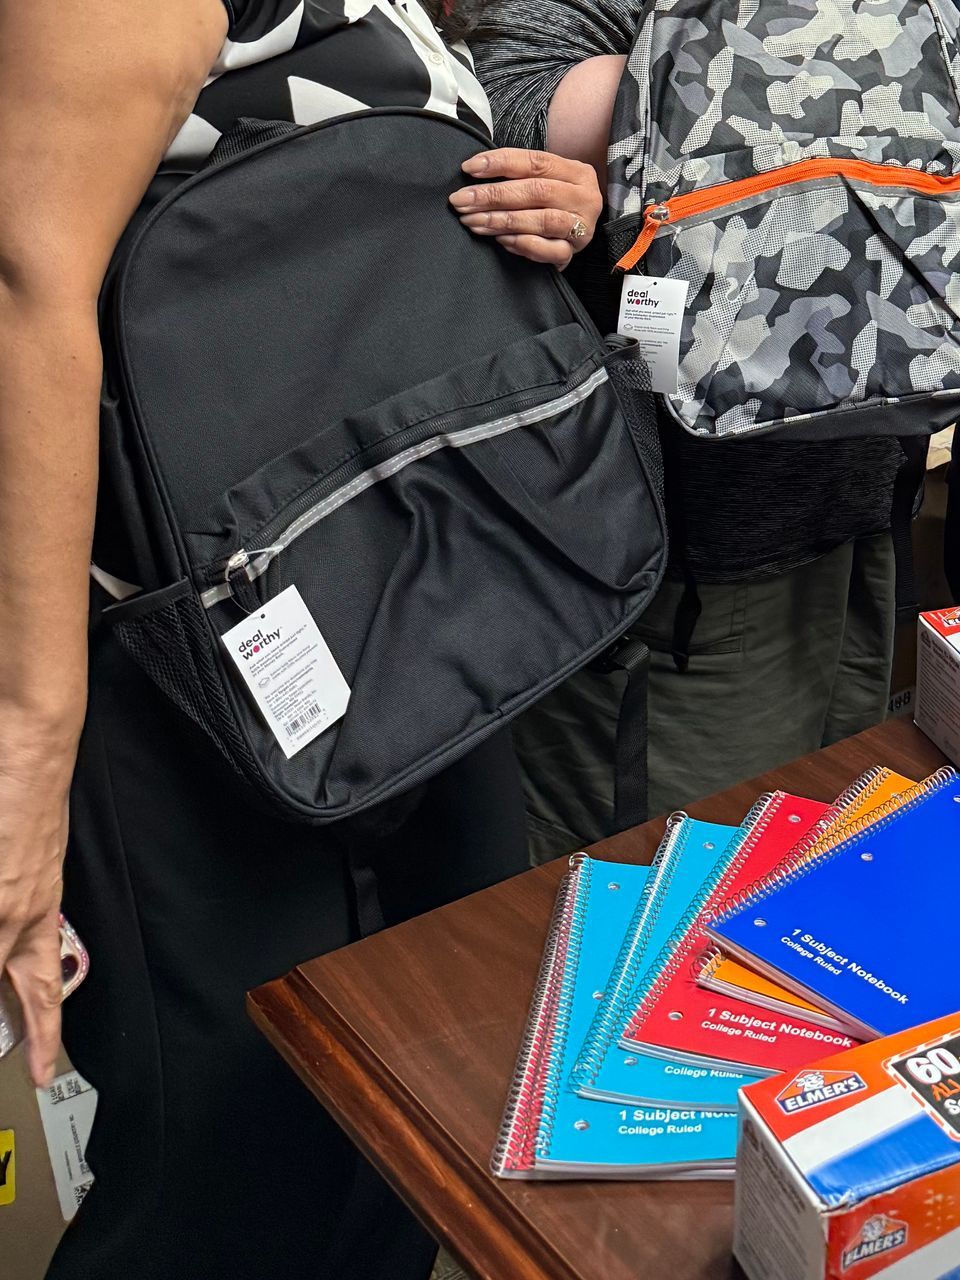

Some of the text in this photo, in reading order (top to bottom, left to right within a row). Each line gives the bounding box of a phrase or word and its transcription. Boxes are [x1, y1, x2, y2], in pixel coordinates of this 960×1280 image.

[627, 289, 649, 298] deal
[627, 297, 659, 308] worthy
[237, 629, 264, 653] deal
[242, 627, 281, 661] worthy
[780, 936, 843, 976] College Ruled
[791, 928, 909, 1005] 1 Subject Notebook
[701, 1021, 777, 1043] College Ruled
[708, 1008, 853, 1048] 1 Subject Notebook
[664, 1065, 708, 1079] College
[784, 1077, 859, 1111] ELMER'S
[619, 1110, 627, 1121] 1
[633, 1109, 696, 1123] Subject
[618, 1123, 702, 1136] College Ruled
[844, 1229, 905, 1266] ELMER'S
